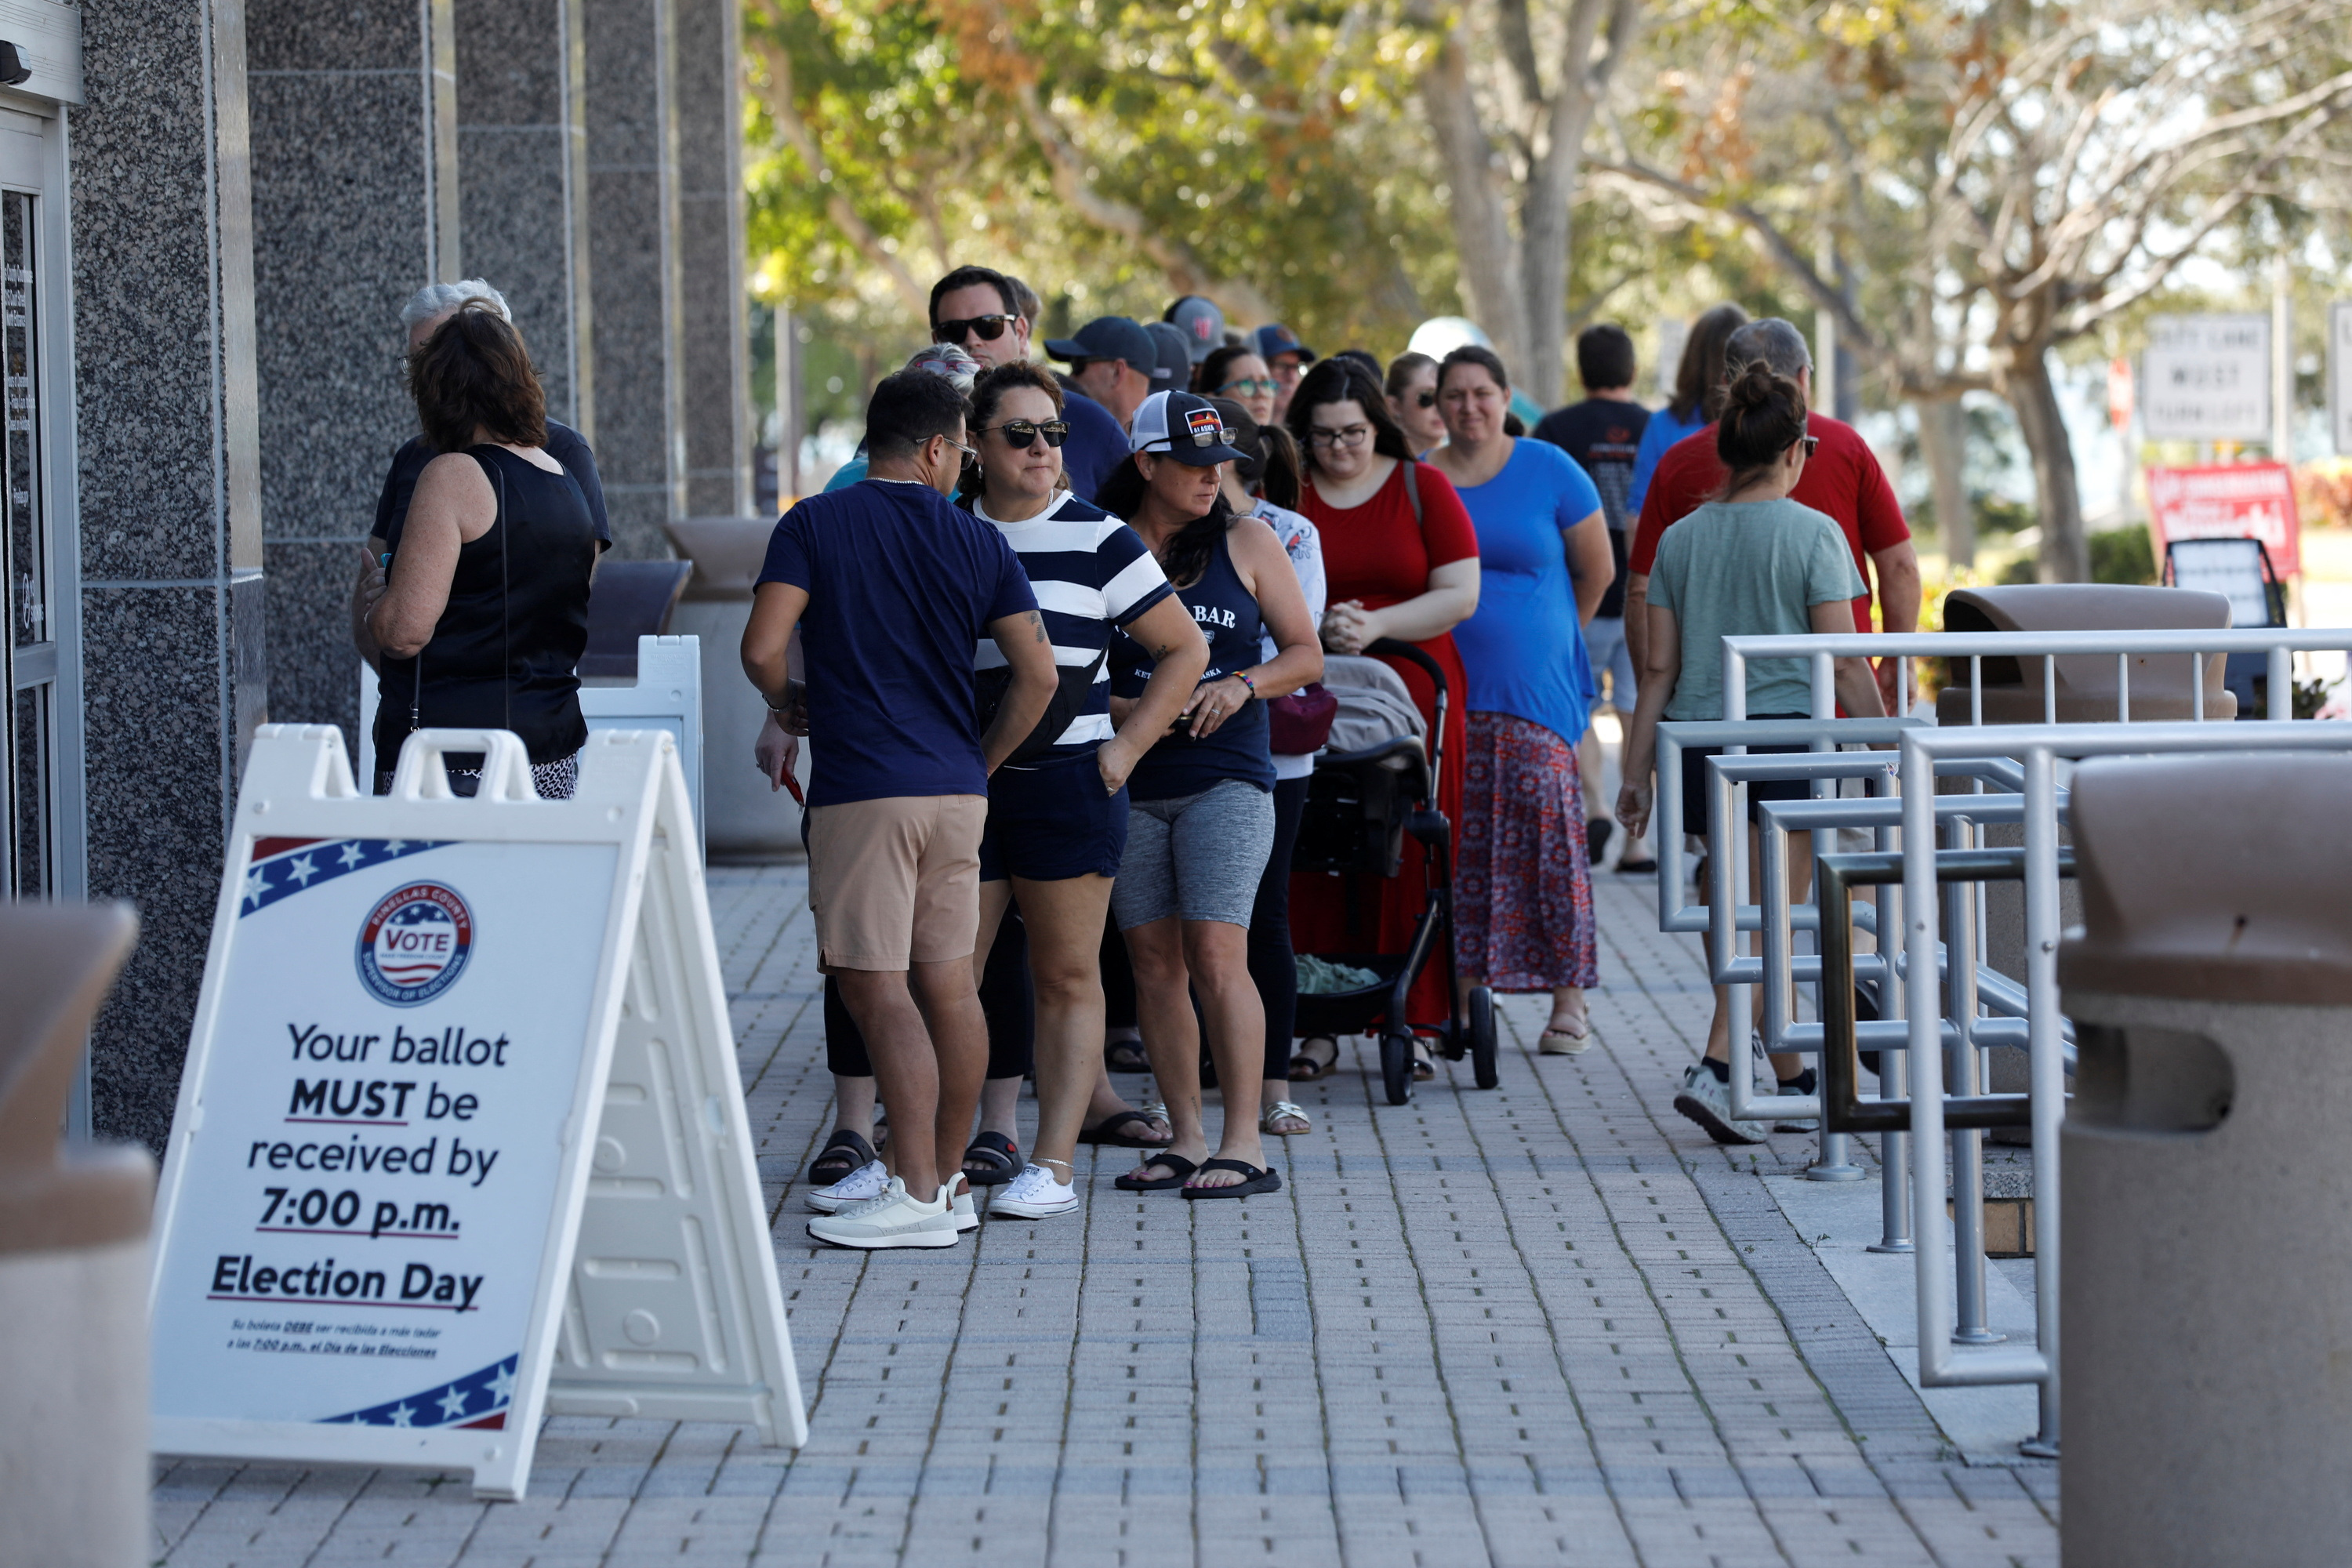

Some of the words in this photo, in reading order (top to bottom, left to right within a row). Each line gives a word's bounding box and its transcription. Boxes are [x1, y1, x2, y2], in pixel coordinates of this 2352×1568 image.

[1193, 605, 1236, 629] BAR
[372, 887, 429, 926] PINELLAS
[432, 888, 468, 929] COUNTY
[386, 929, 450, 952] VOTE
[363, 950, 400, 999] SUPERVISOR
[418, 953, 465, 999] ELECTIONS
[287, 1023, 380, 1062] Your
[390, 1025, 510, 1067] ballot
[289, 1078, 416, 1118] MUST
[424, 1081, 479, 1120] be
[247, 1134, 438, 1174] received
[447, 1138, 499, 1188] by
[260, 1187, 361, 1228] 7:00
[370, 1201, 461, 1239] p.m.
[211, 1254, 387, 1299] Election
[400, 1262, 484, 1313] Day
[282, 1321, 314, 1333] DEBE
